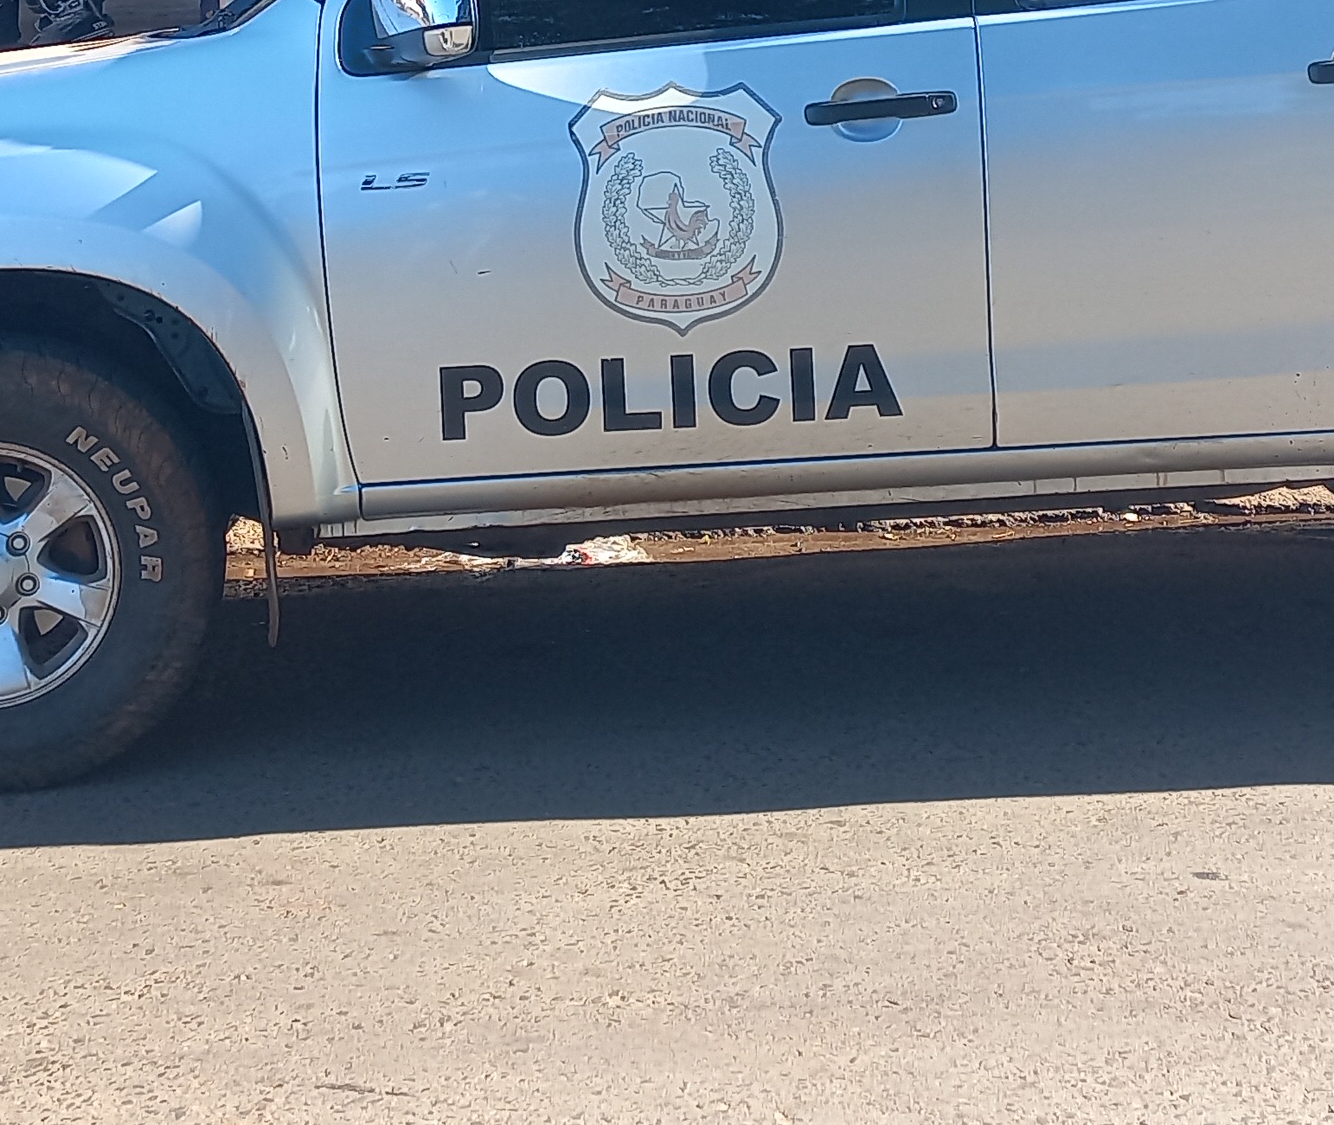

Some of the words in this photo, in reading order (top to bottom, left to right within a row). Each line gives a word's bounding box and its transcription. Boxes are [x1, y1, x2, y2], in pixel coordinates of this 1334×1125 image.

[616, 112, 664, 138] POLICIA
[668, 110, 732, 132] NACIONAL
[360, 172, 431, 191] LS
[635, 290, 728, 310] PARAGUAY
[438, 344, 904, 442] POLICIA
[65, 426, 163, 583] NEUPAR
